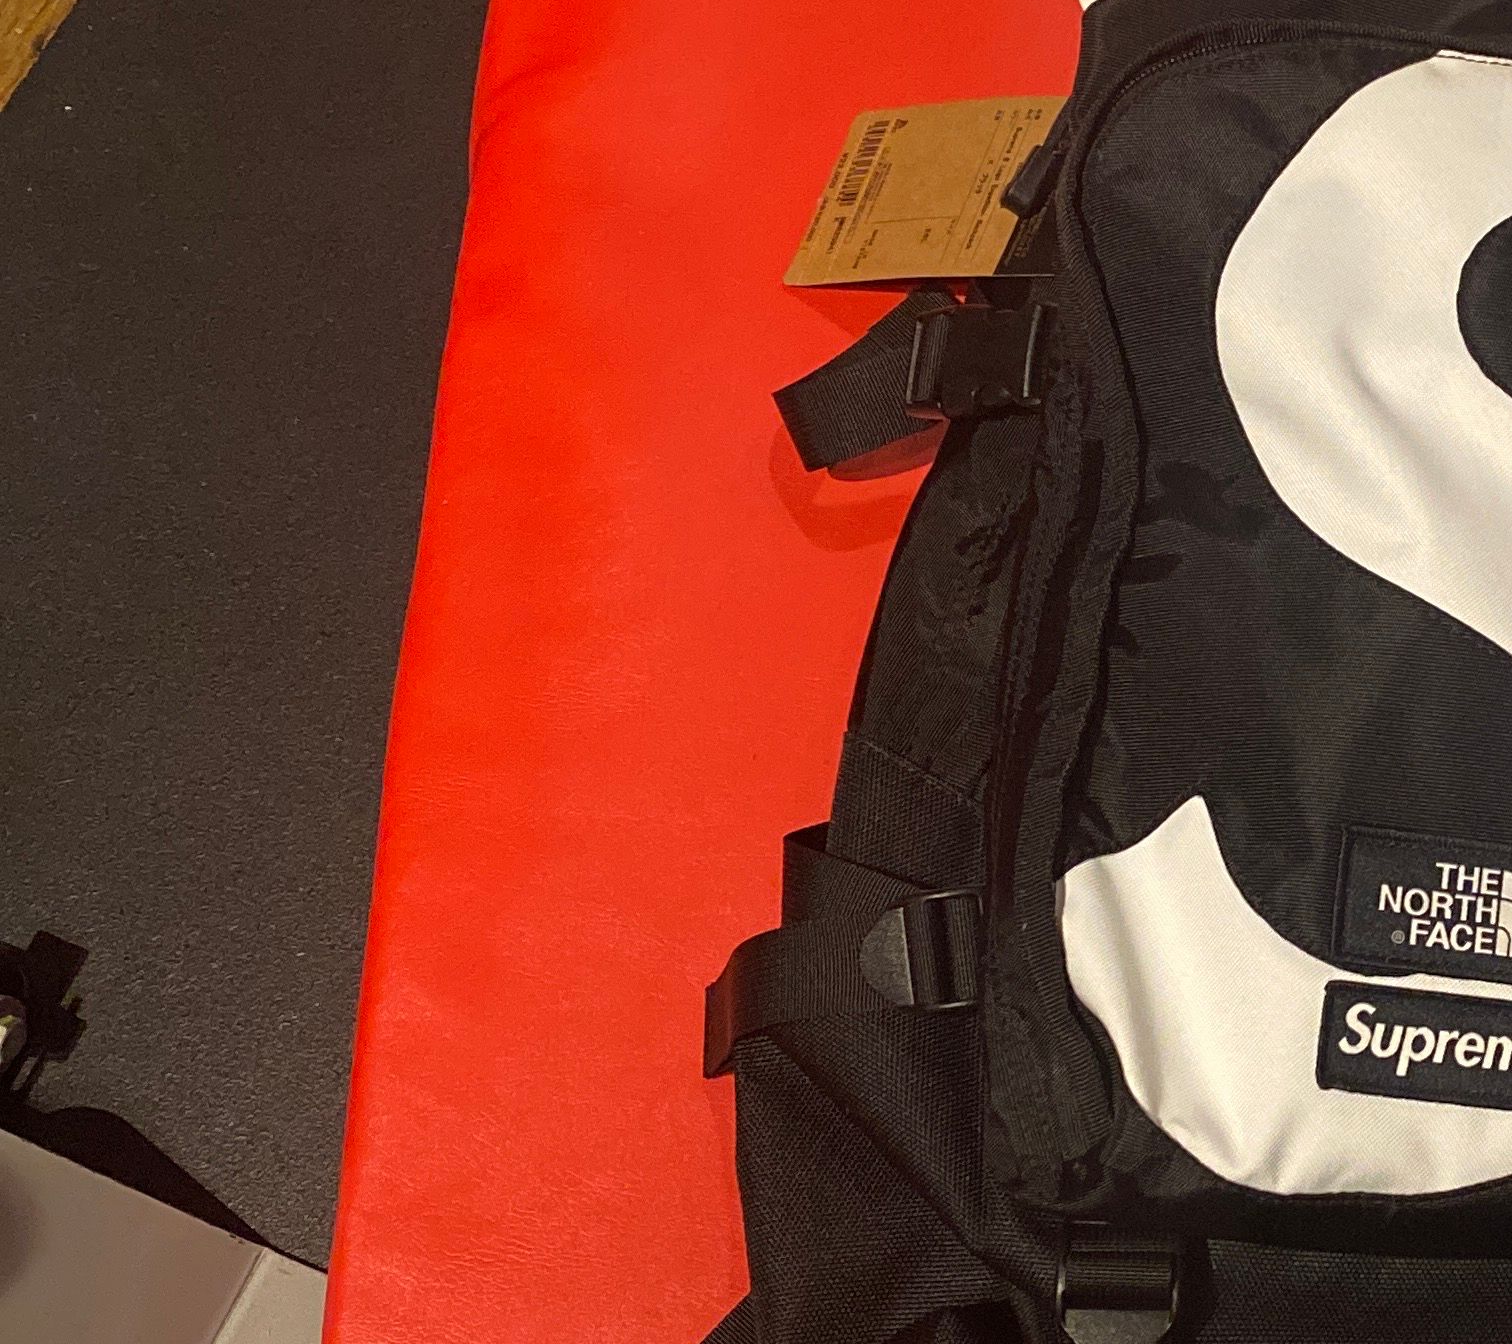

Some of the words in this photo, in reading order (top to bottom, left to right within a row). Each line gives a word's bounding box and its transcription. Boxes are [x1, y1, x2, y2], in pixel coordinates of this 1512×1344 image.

[1435, 862, 1502, 895] THE
[1377, 884, 1499, 925] NORTH
[1408, 918, 1496, 955] FACE
